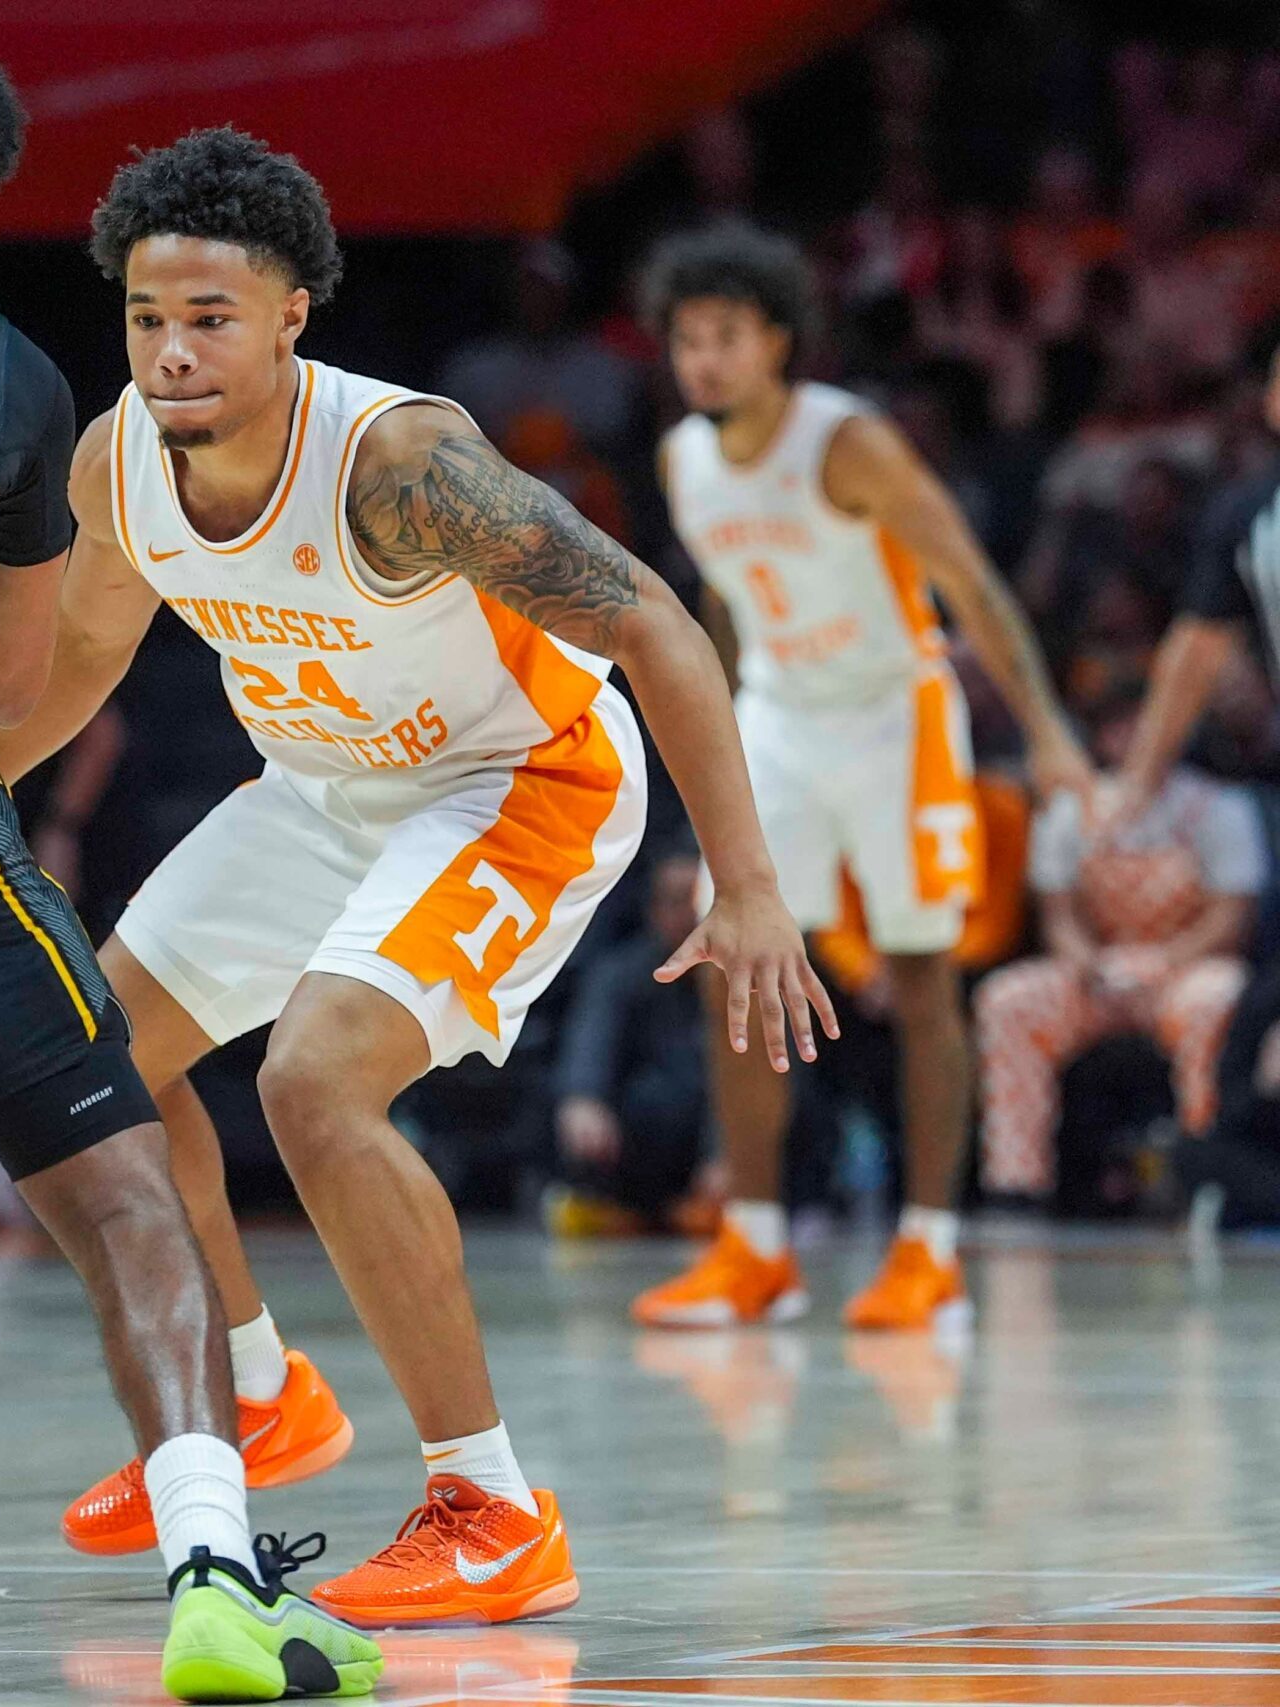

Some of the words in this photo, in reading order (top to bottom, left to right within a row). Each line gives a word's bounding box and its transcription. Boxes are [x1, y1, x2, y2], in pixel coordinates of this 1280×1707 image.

[228, 655, 375, 721] 24
[452, 858, 538, 973] T
[69, 1086, 114, 1115] AEROREADY
